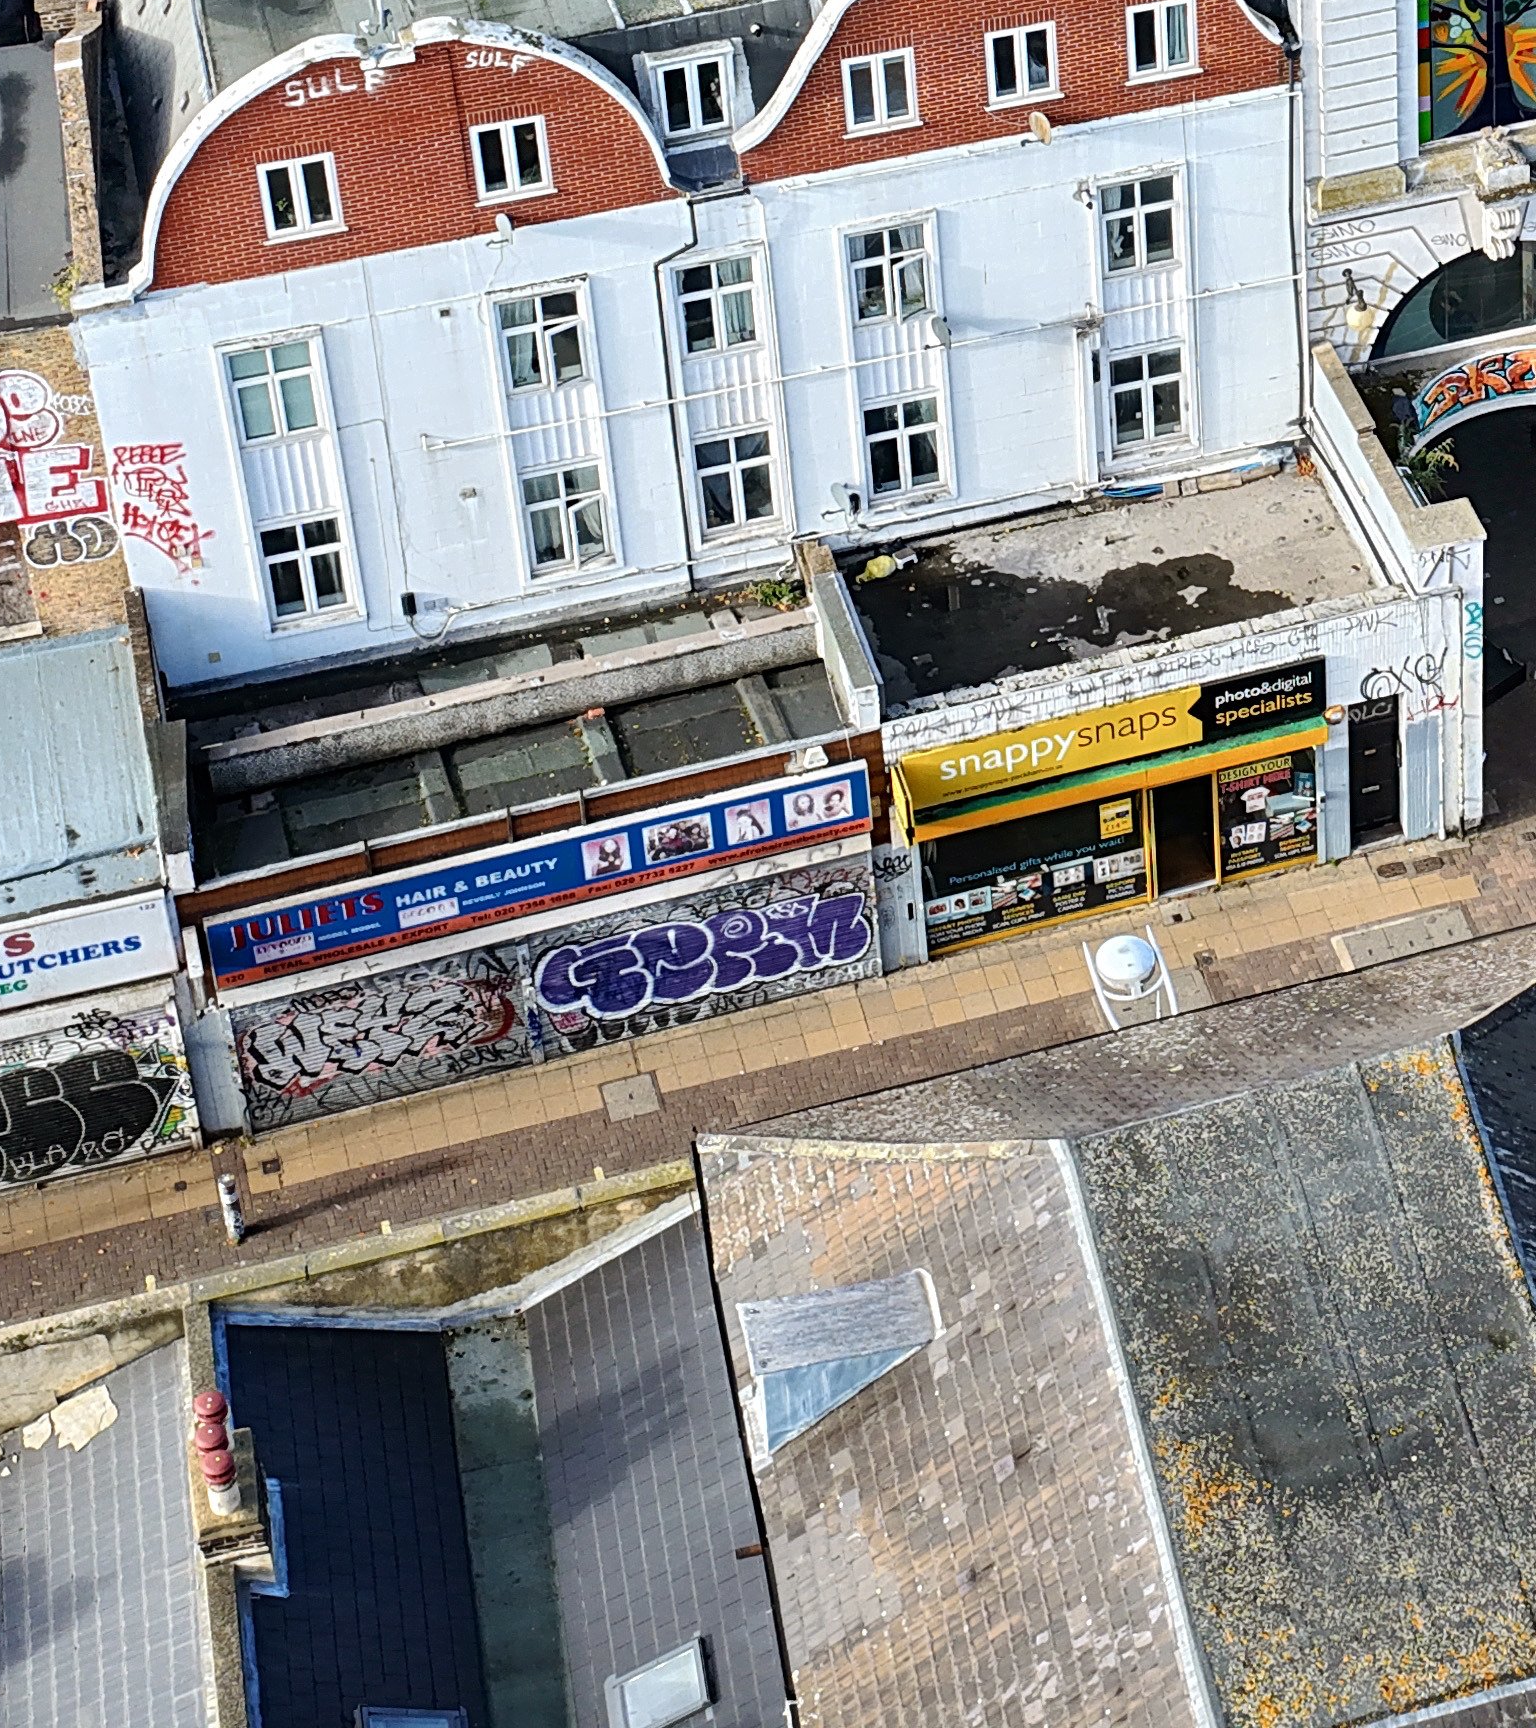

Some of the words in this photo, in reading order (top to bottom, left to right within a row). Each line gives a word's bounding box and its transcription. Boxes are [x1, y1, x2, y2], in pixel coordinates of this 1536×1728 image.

[1214, 671, 1314, 710] photo&digital
[1214, 691, 1314, 727] specialists
[1219, 765, 1258, 782] DESIGN
[1263, 757, 1291, 772] YOUR
[395, 884, 447, 908] HAIR
[454, 880, 469, 893] &
[475, 857, 558, 888] BEAUTY
[949, 862, 1017, 886] Personalised
[1019, 856, 1042, 871] gifts
[1044, 848, 1073, 863] while
[1075, 843, 1096, 857] you
[225, 973, 245, 984] 120
[401, 921, 451, 942] EXPORT
